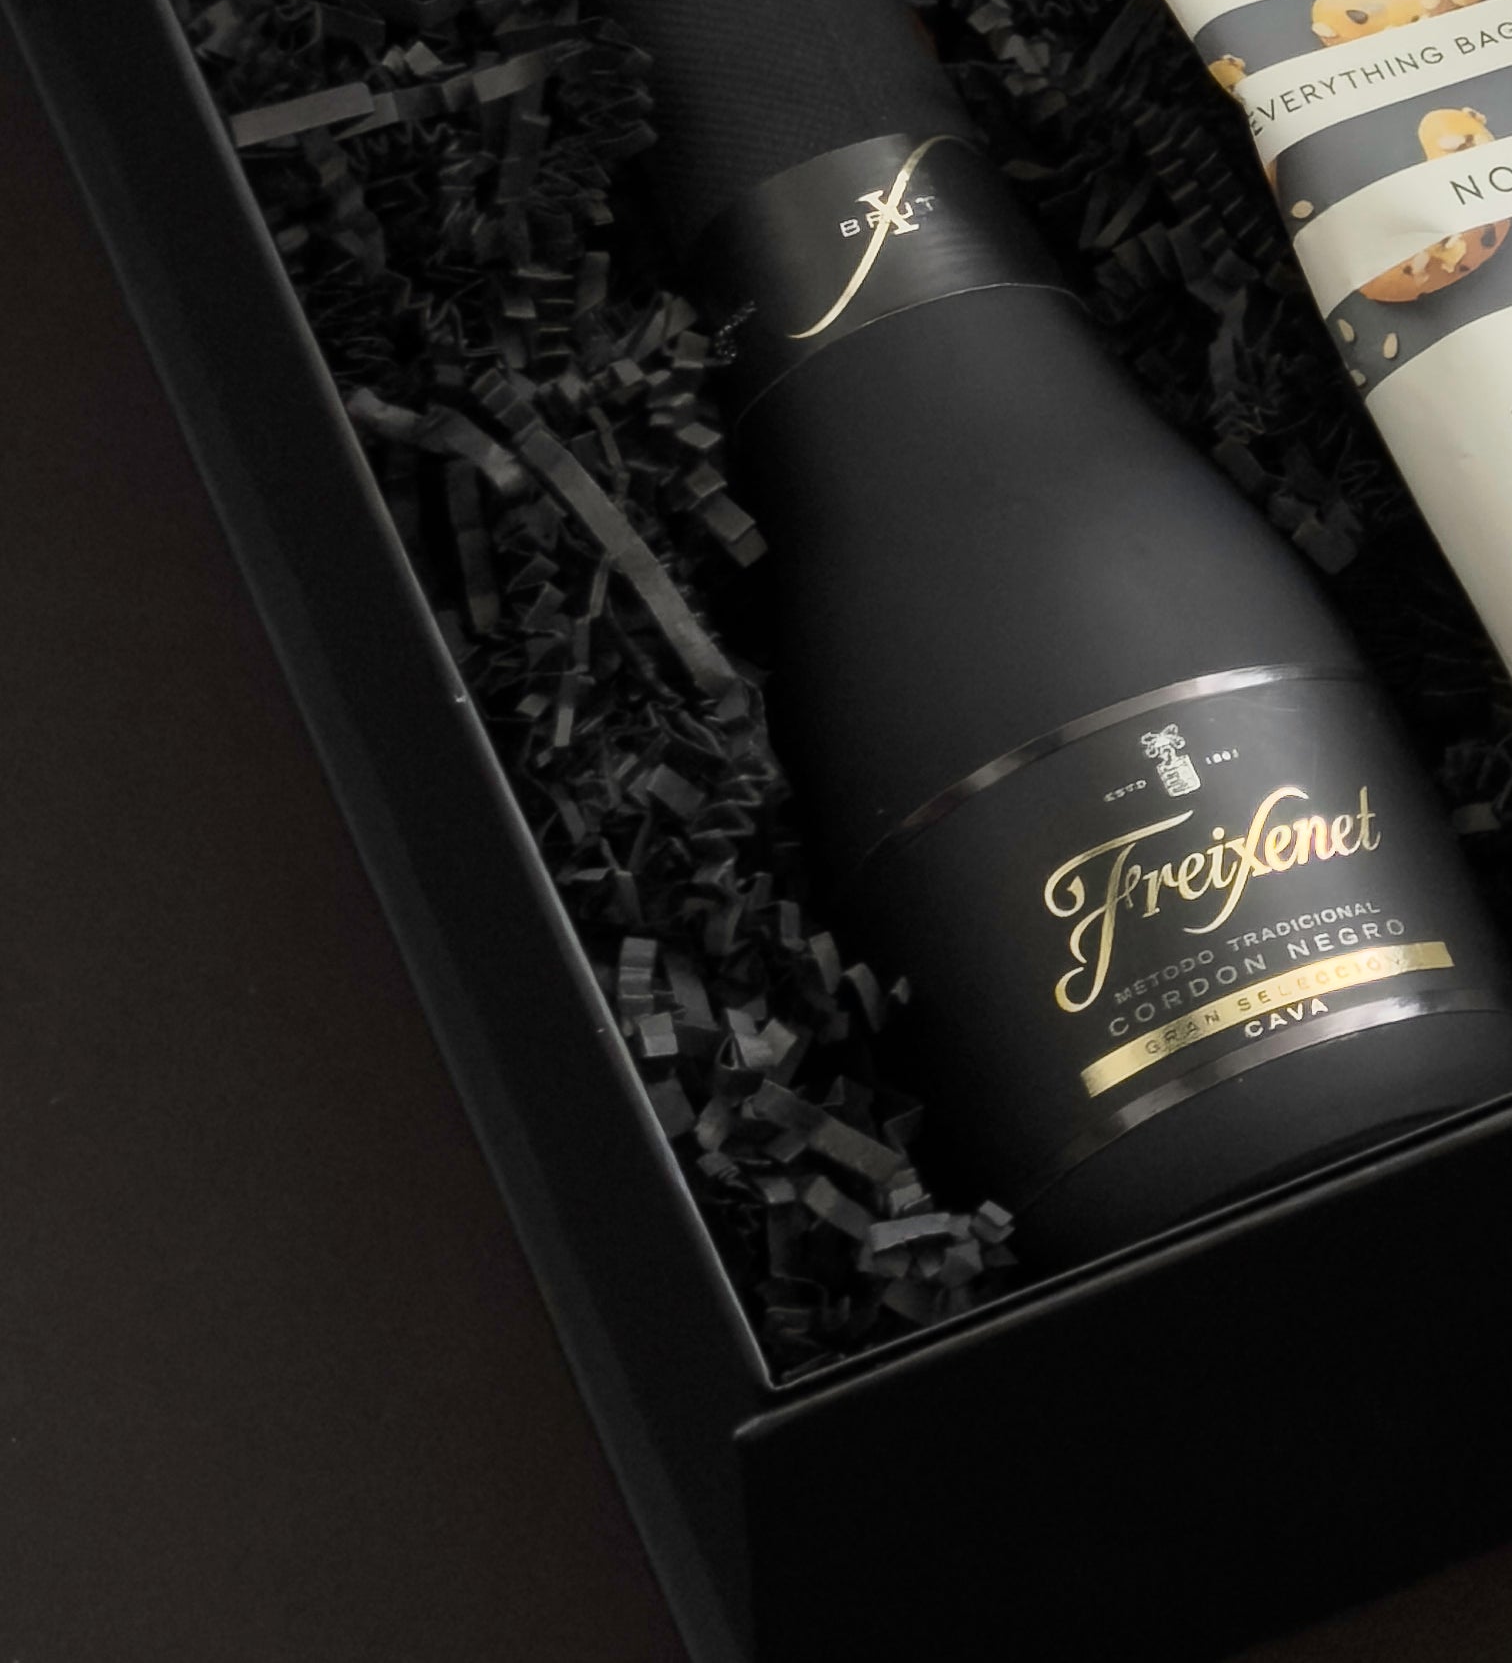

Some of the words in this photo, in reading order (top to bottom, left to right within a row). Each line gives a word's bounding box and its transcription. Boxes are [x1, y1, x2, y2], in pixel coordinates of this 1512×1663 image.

[1248, 46, 1444, 138] EVERYTHING
[1044, 785, 1382, 1014] Freixenet
[1226, 900, 1381, 953] TRADICIONAL
[1108, 953, 1268, 1038] CORDON
[1287, 918, 1405, 961] NEGRO
[1145, 1009, 1220, 1056] GRAN
[1245, 997, 1329, 1039] CAVA
